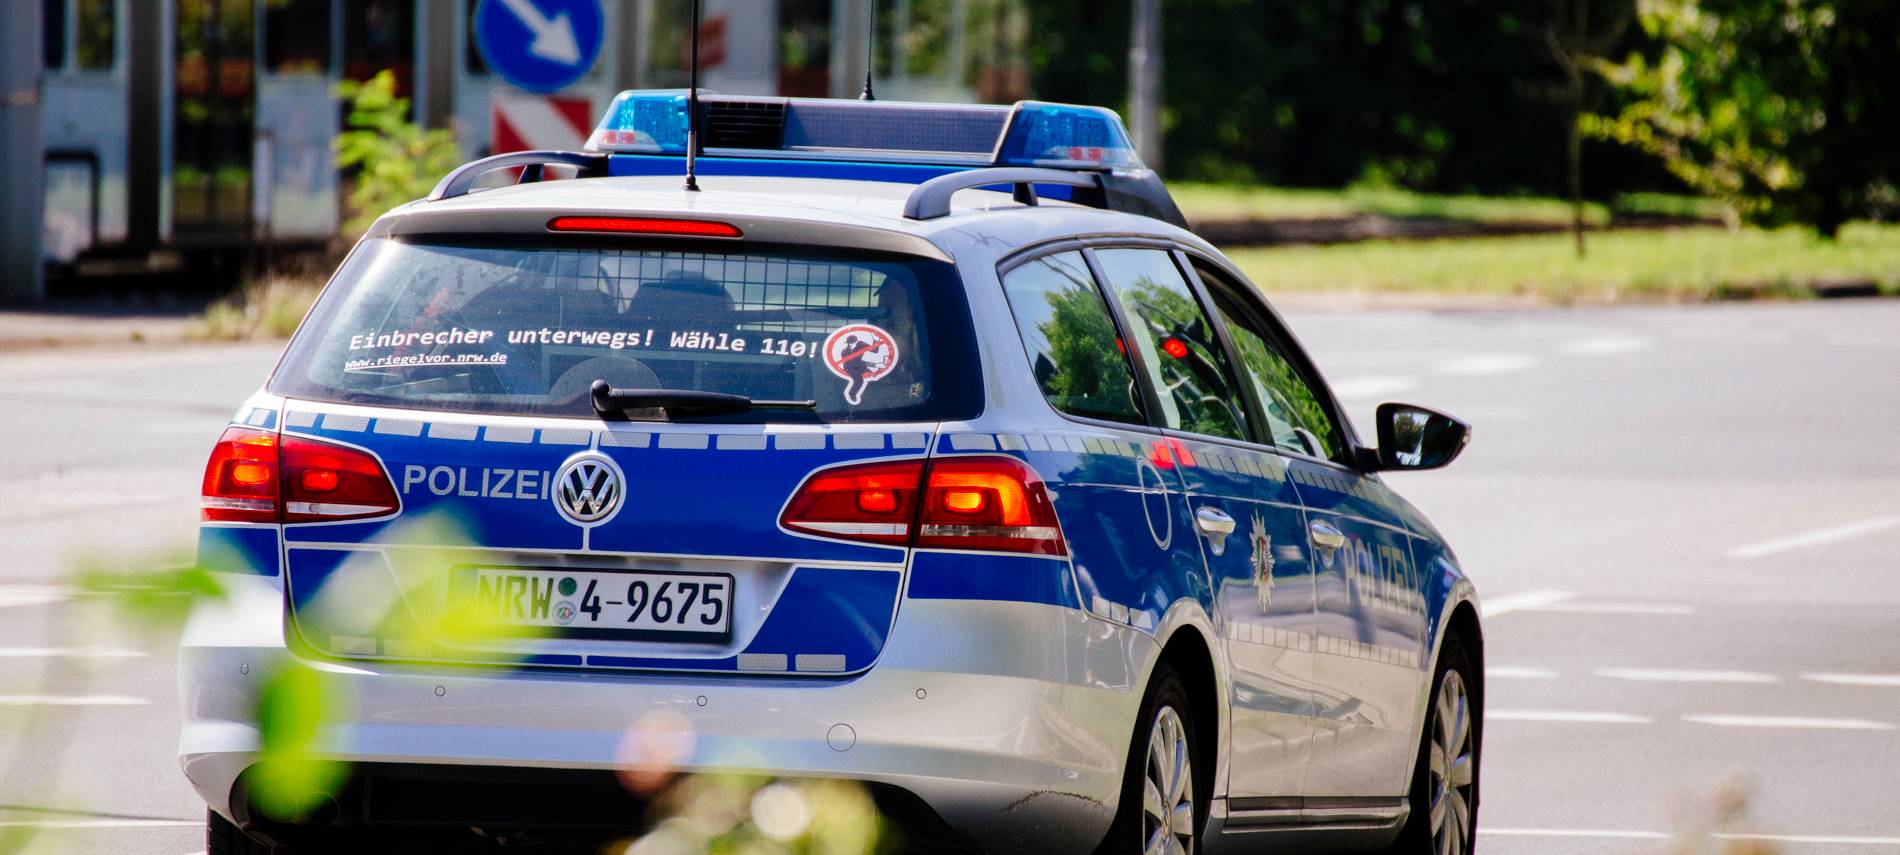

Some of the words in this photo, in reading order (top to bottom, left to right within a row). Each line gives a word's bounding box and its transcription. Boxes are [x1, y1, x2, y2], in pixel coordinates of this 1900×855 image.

[349, 327, 494, 351] Einbrecher
[508, 326, 654, 349] unterwegs!
[670, 331, 746, 353] Wähle
[761, 337, 818, 359] 110!
[344, 352, 508, 371] www.riegelvor.nrw.de
[403, 464, 550, 501] POLIZEI
[1343, 536, 1412, 616] POLIZEI
[476, 574, 554, 621] NRW
[580, 579, 725, 626] 4-9675
